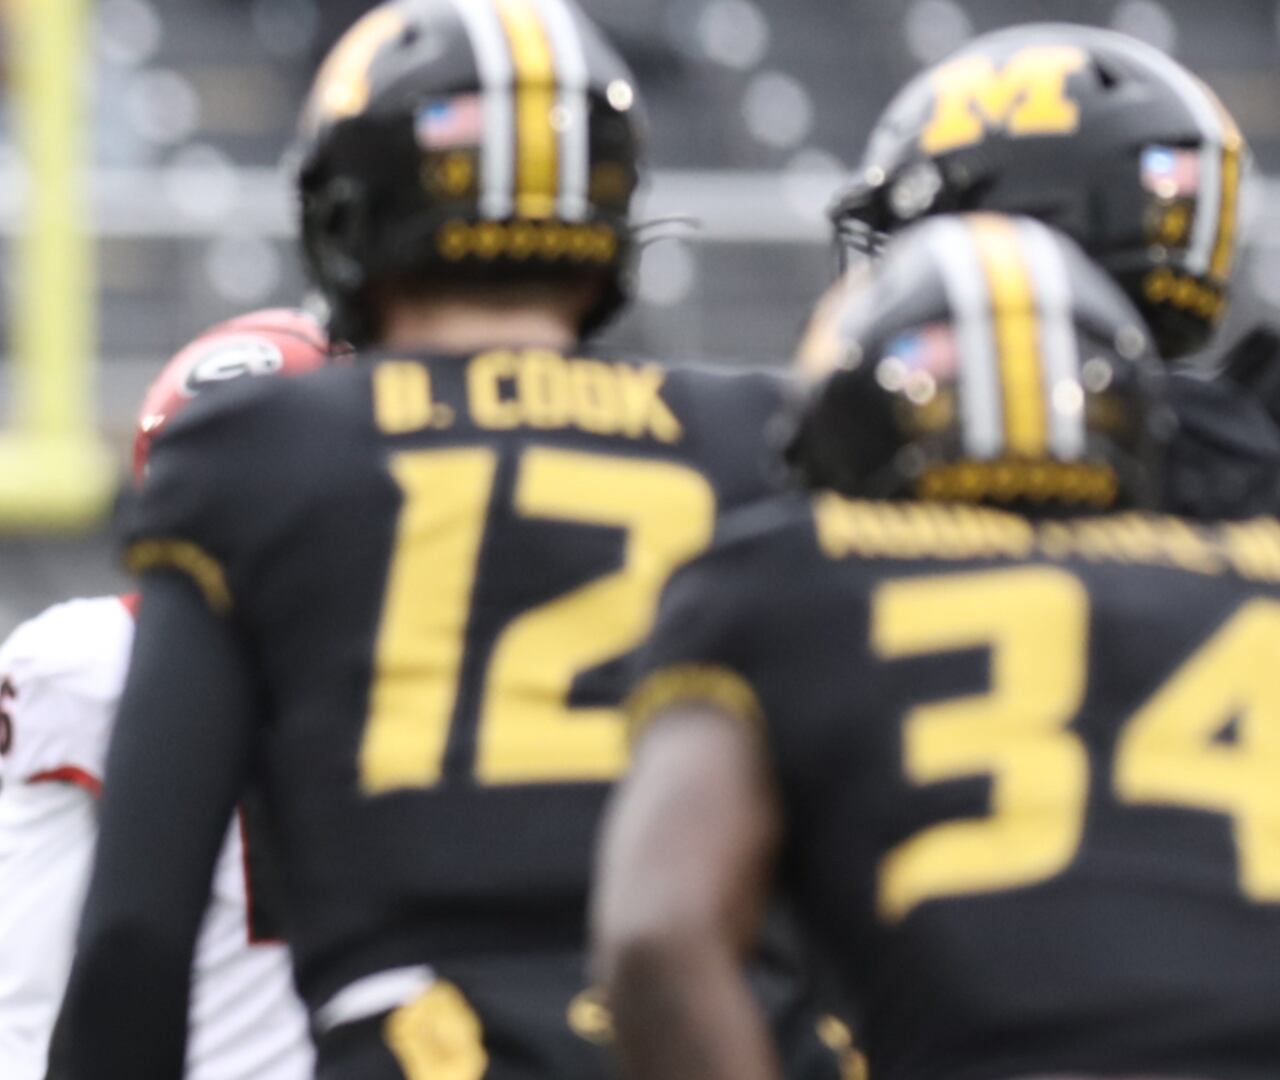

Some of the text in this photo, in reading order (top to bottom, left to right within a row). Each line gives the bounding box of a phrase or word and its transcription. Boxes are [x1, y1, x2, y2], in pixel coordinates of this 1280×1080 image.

[920, 45, 1085, 154] M
[372, 349, 684, 443] B. COOK
[356, 446, 716, 796] 12
[870, 564, 1280, 924] 34
